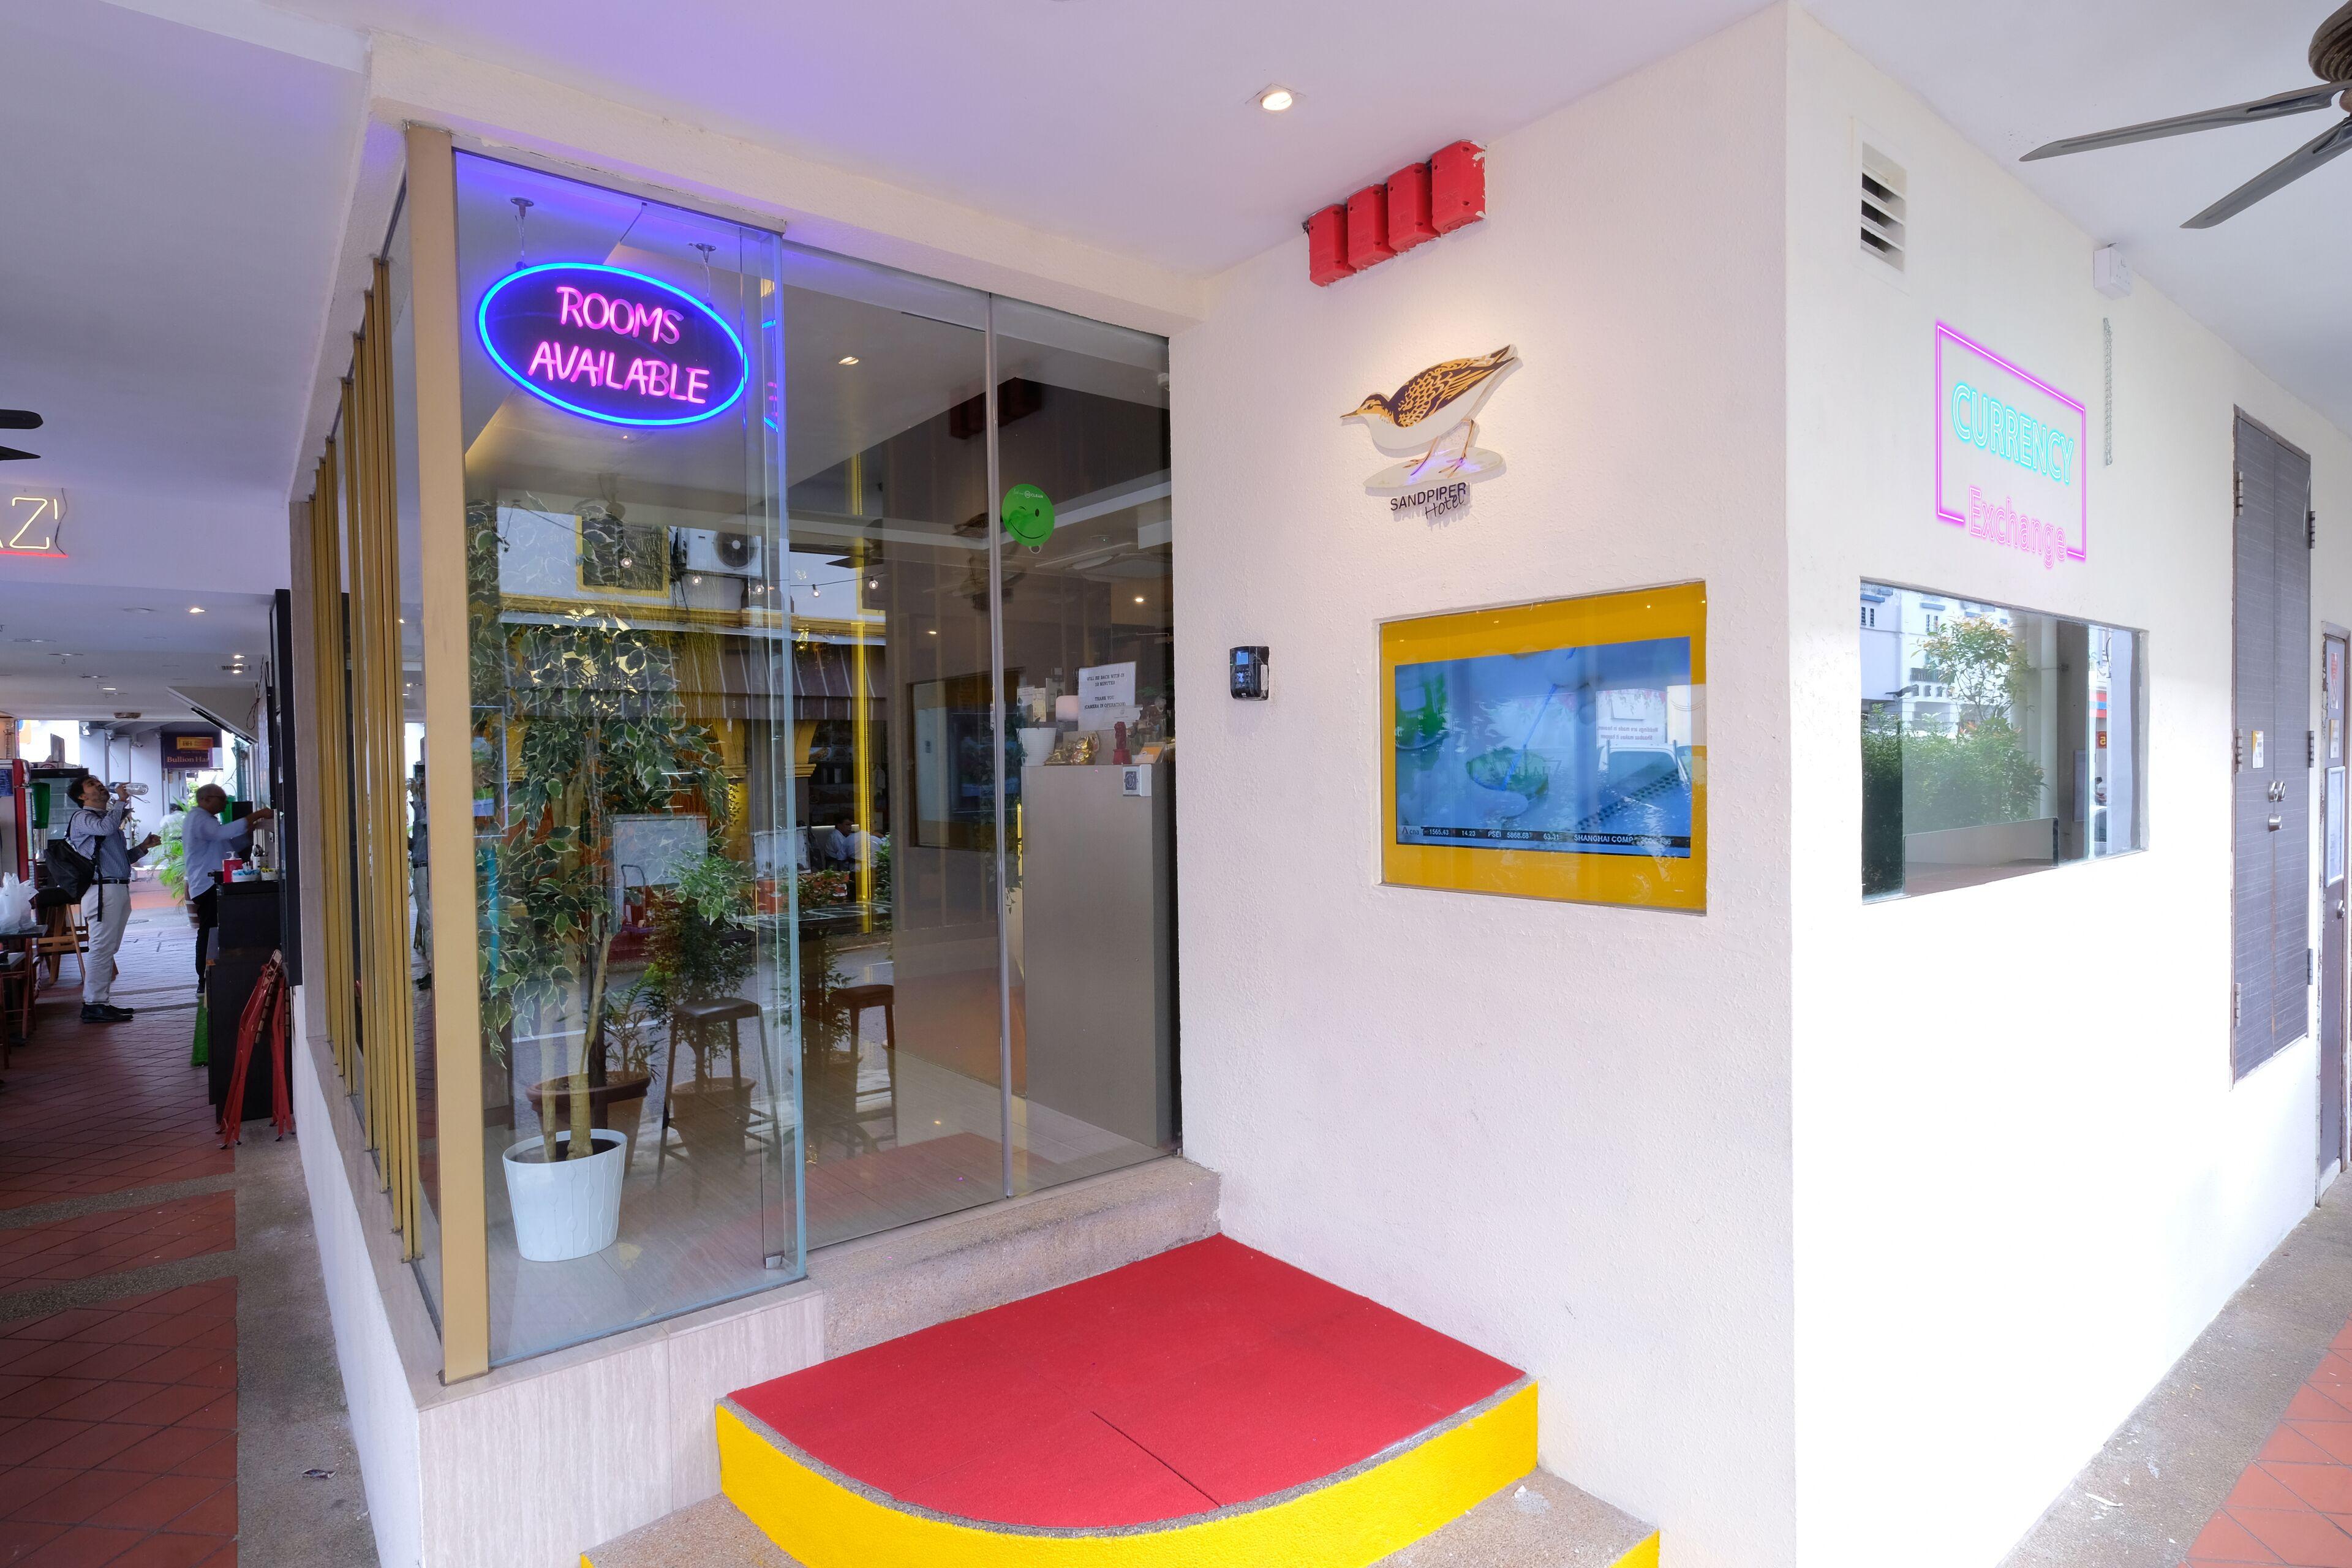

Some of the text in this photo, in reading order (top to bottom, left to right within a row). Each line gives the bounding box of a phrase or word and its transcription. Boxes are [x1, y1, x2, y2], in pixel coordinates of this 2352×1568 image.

[556, 285, 684, 344] ROOMS
[527, 341, 710, 405] AVAILABLE
[1951, 383, 2074, 484] CURRENCY
[1390, 481, 1467, 511] SANDPIPER
[1425, 492, 1465, 519] Hotel
[1969, 485, 2067, 568] Exchange
[1574, 834, 1610, 843] SHANGHAI
